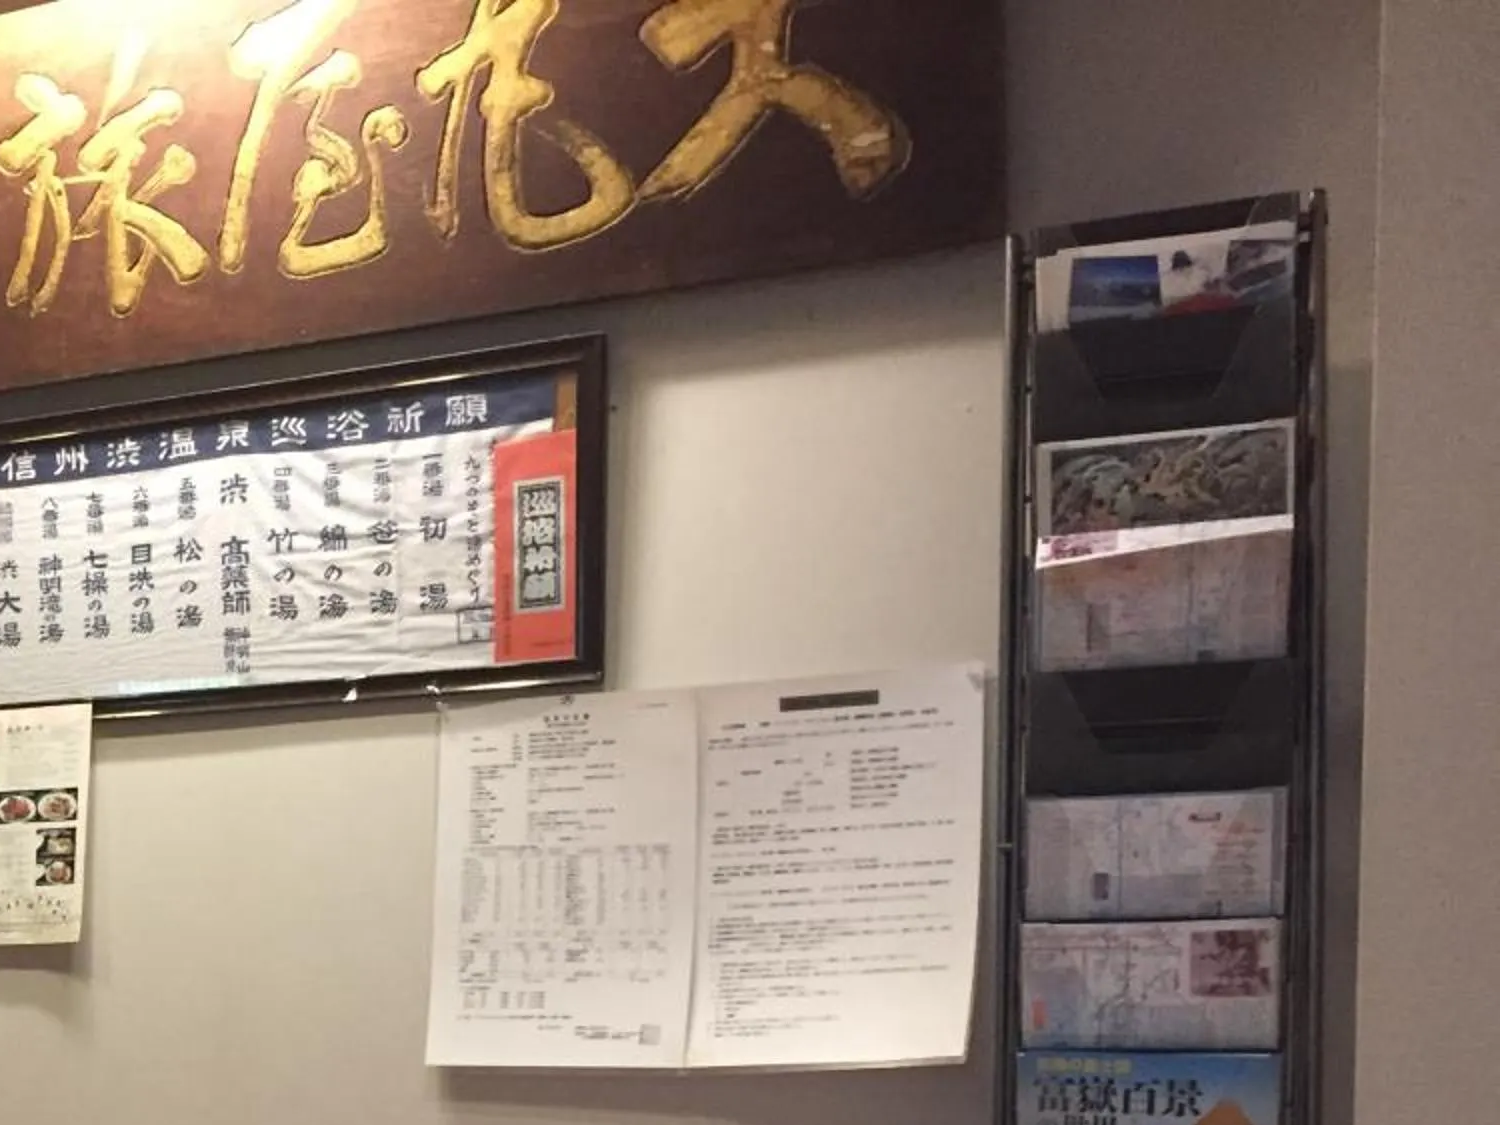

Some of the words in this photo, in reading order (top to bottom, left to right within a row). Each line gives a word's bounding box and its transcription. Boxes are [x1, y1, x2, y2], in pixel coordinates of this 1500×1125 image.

[0, 394, 488, 482] 信州渋温泉巡浴祈願
[173, 536, 204, 629] 松の湯
[267, 526, 299, 622] 竹の湯
